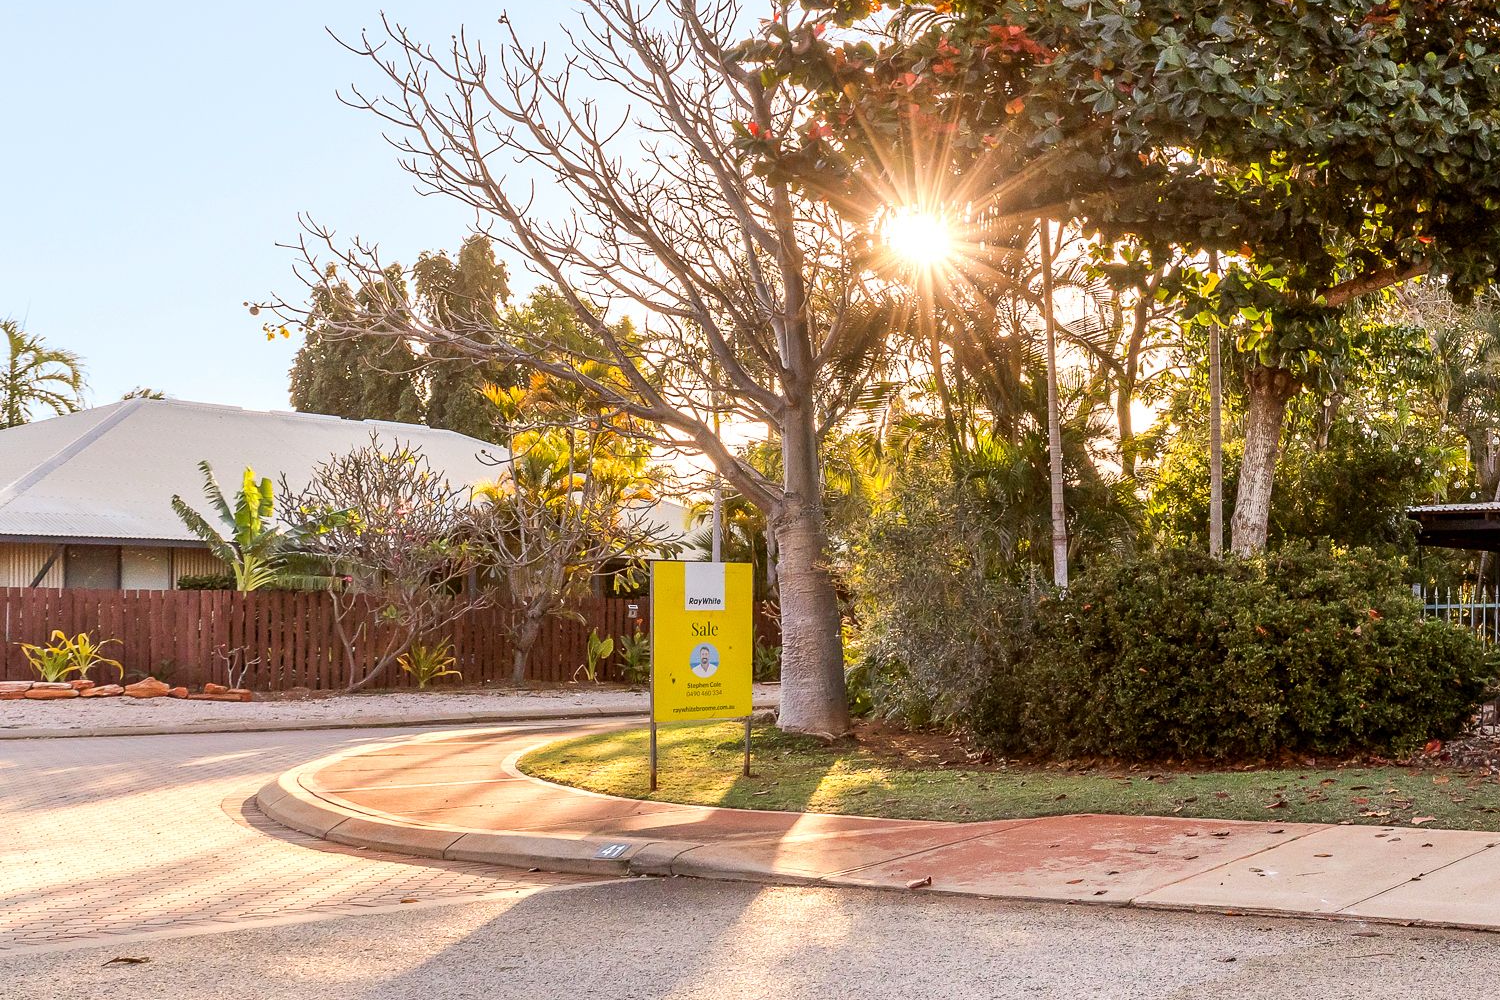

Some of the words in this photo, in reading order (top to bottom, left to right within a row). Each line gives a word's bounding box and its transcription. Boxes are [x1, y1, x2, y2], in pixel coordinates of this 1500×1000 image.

[689, 597, 721, 606] RayWhite
[691, 621, 718, 636] Sale
[672, 705, 735, 713] raywhitebroome.com.au
[601, 844, 626, 857] 41
